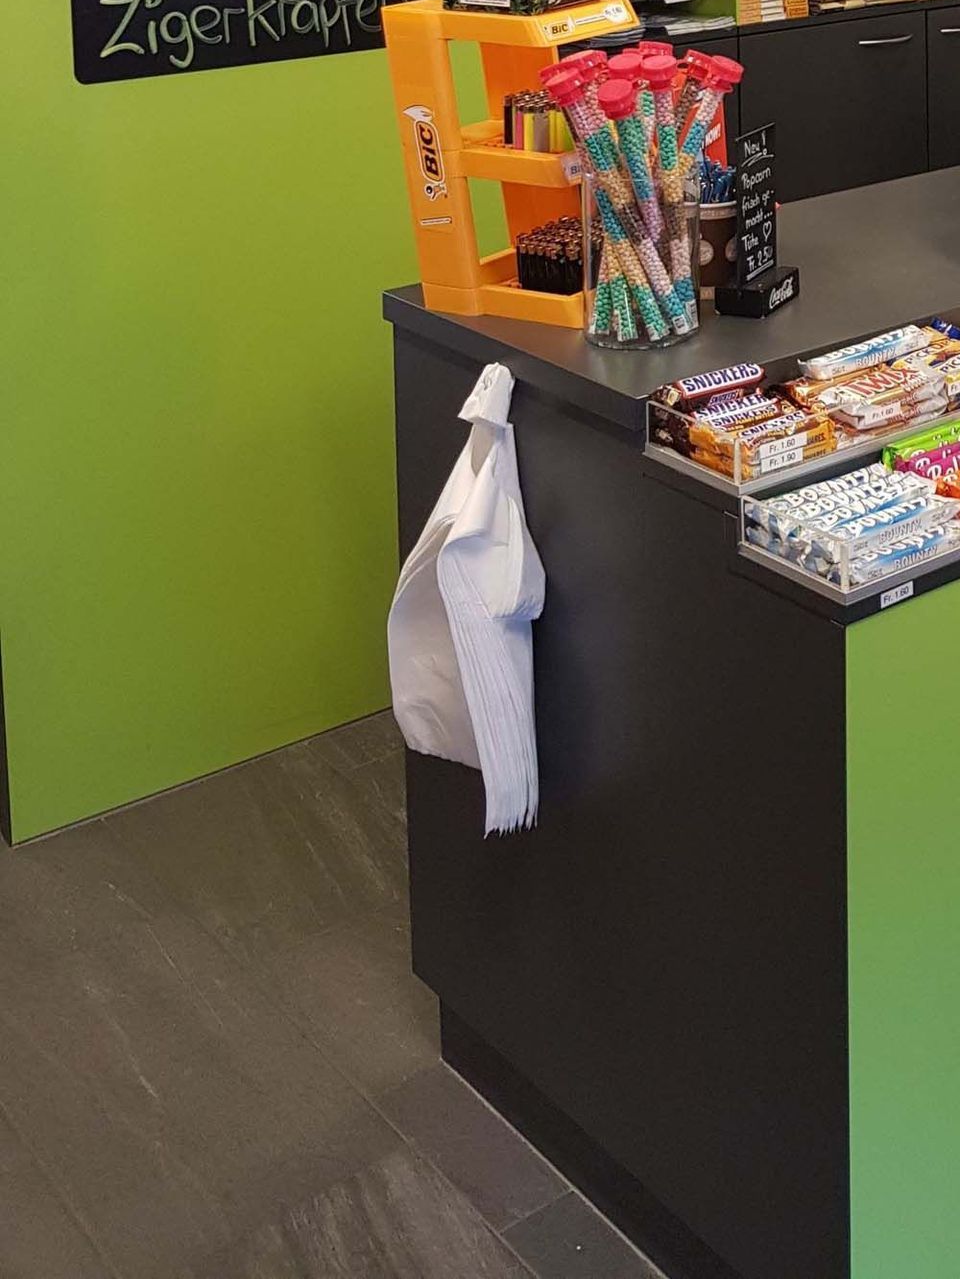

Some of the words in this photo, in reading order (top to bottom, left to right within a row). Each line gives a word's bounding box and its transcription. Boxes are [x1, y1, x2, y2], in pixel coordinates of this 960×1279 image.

[418, 126, 442, 177] BIC
[741, 167, 771, 190] Popcorn
[742, 193, 759, 216] frisch
[855, 347, 896, 366] BOUNTY
[906, 348, 932, 365] PICK
[683, 363, 760, 393] SNICKERS
[847, 366, 919, 397] TWIX
[769, 444, 779, 453] Fr.
[781, 439, 796, 450] 1.60
[769, 458, 779, 466] Fr.
[781, 452, 796, 464] 1.90
[788, 468, 869, 504] BOUNTY
[865, 524, 943, 562] BOUNTY
[879, 519, 921, 544] BOUNTY
[894, 546, 938, 570] BOUNTY
[884, 592, 893, 603] Fr.
[895, 586, 909, 599] 1.60
